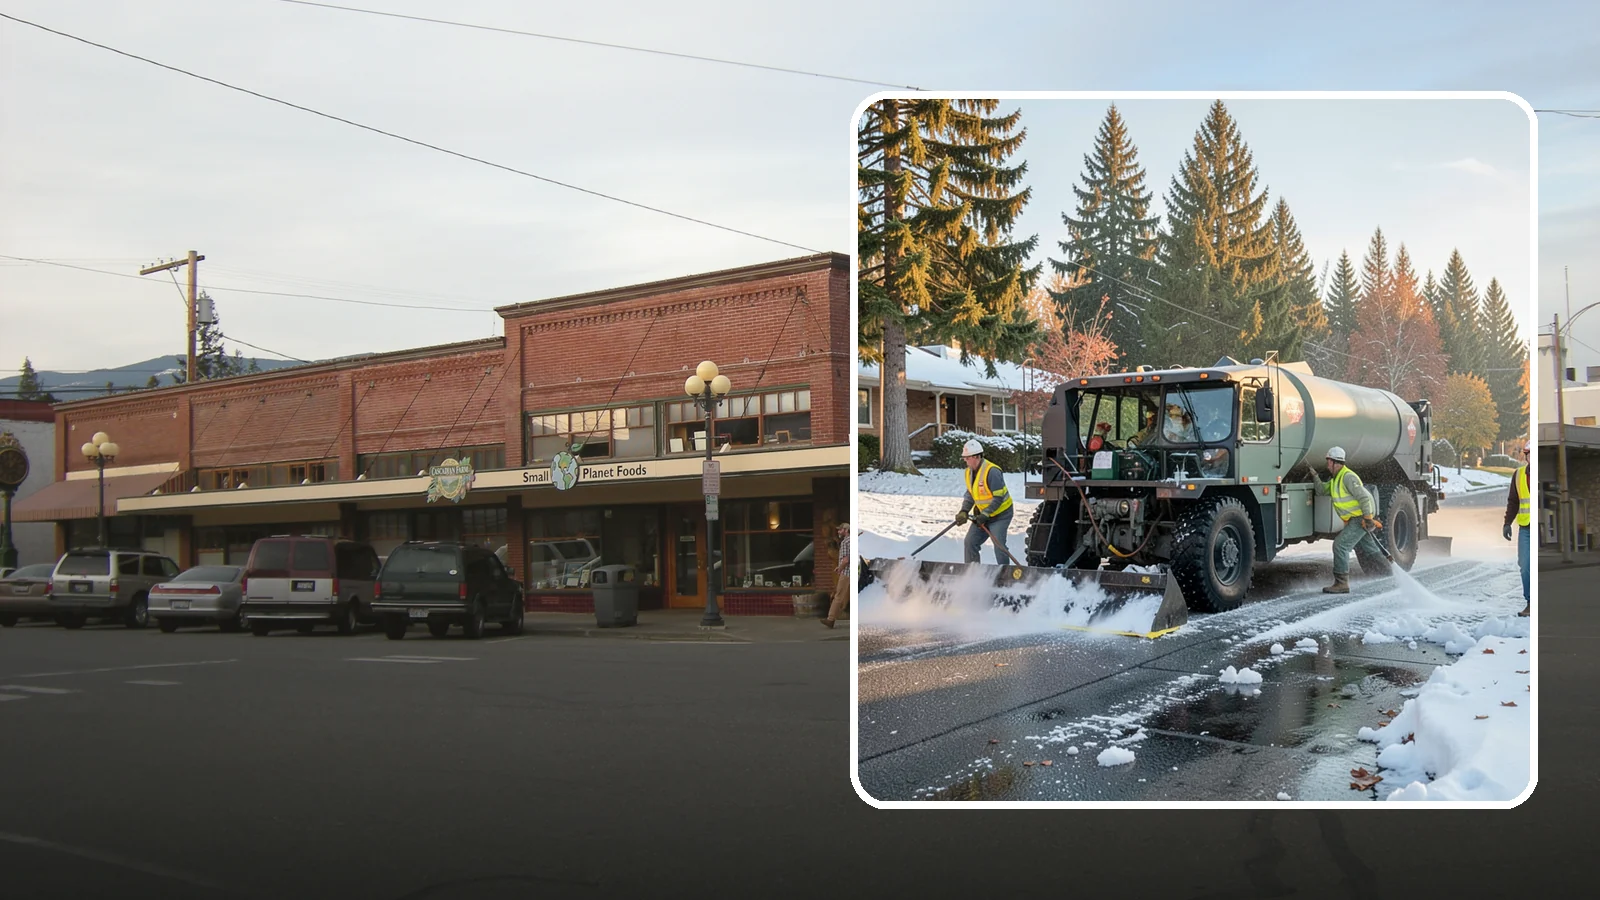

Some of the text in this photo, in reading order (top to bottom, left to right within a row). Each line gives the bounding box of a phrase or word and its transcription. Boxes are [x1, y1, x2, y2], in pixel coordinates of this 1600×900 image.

[523, 464, 647, 483] Small Planet Foods
